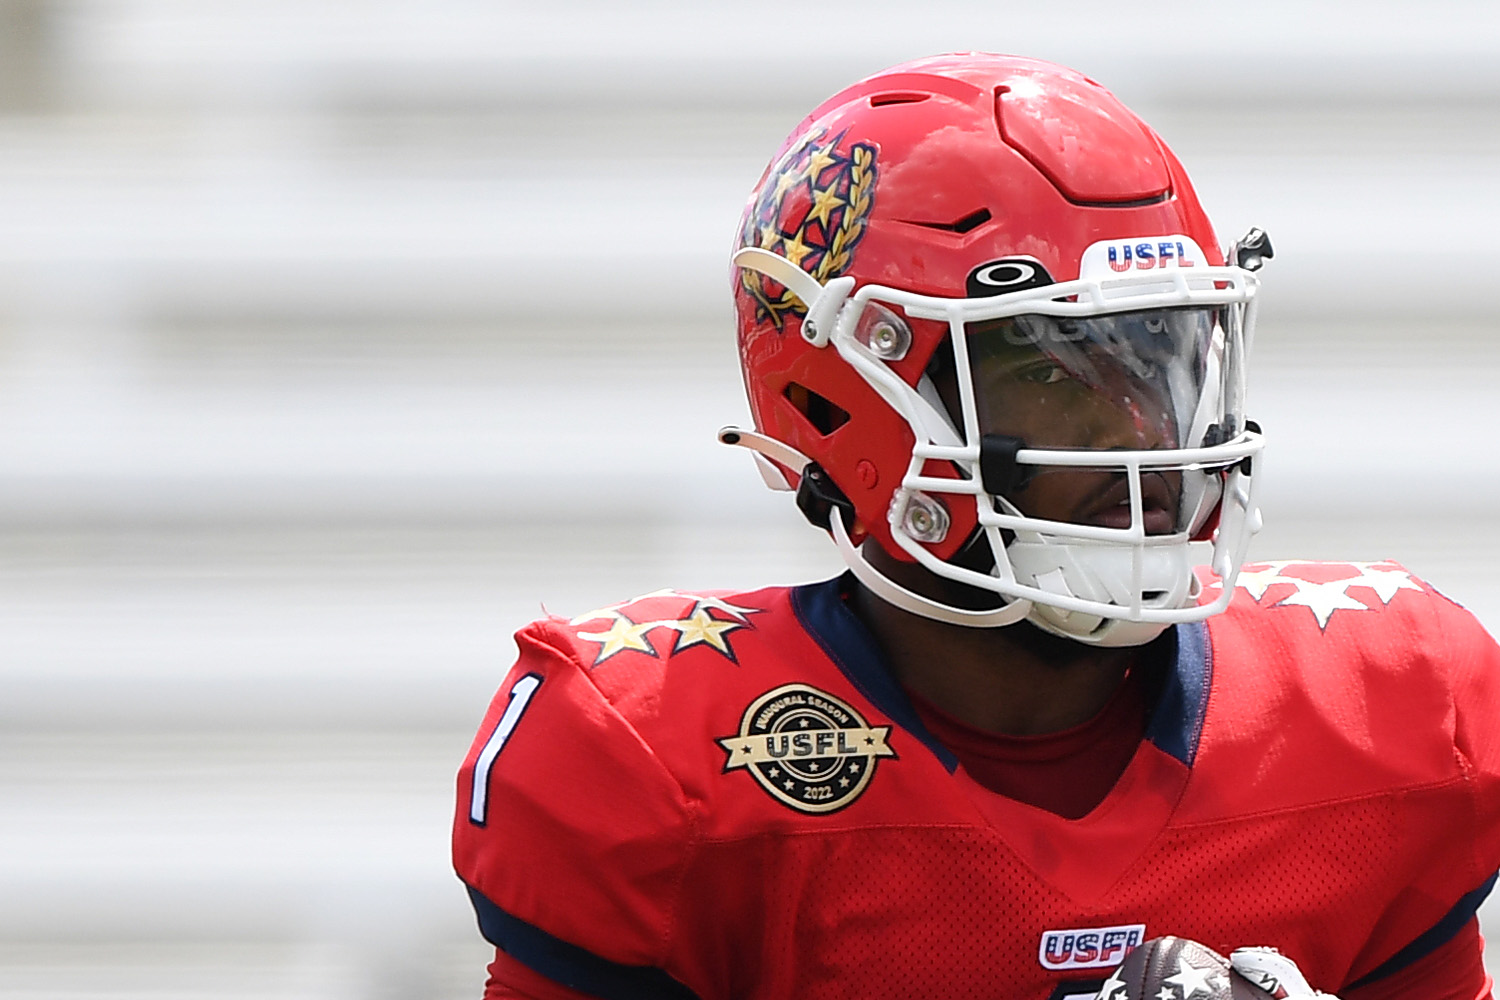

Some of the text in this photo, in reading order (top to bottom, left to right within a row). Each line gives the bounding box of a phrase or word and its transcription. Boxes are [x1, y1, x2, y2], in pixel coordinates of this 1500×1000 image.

[1107, 241, 1195, 272] USFL
[755, 695, 849, 730] INAUGURAL SEASON
[469, 671, 545, 828] 1
[766, 731, 858, 758] USFL
[803, 785, 834, 800] 2022
